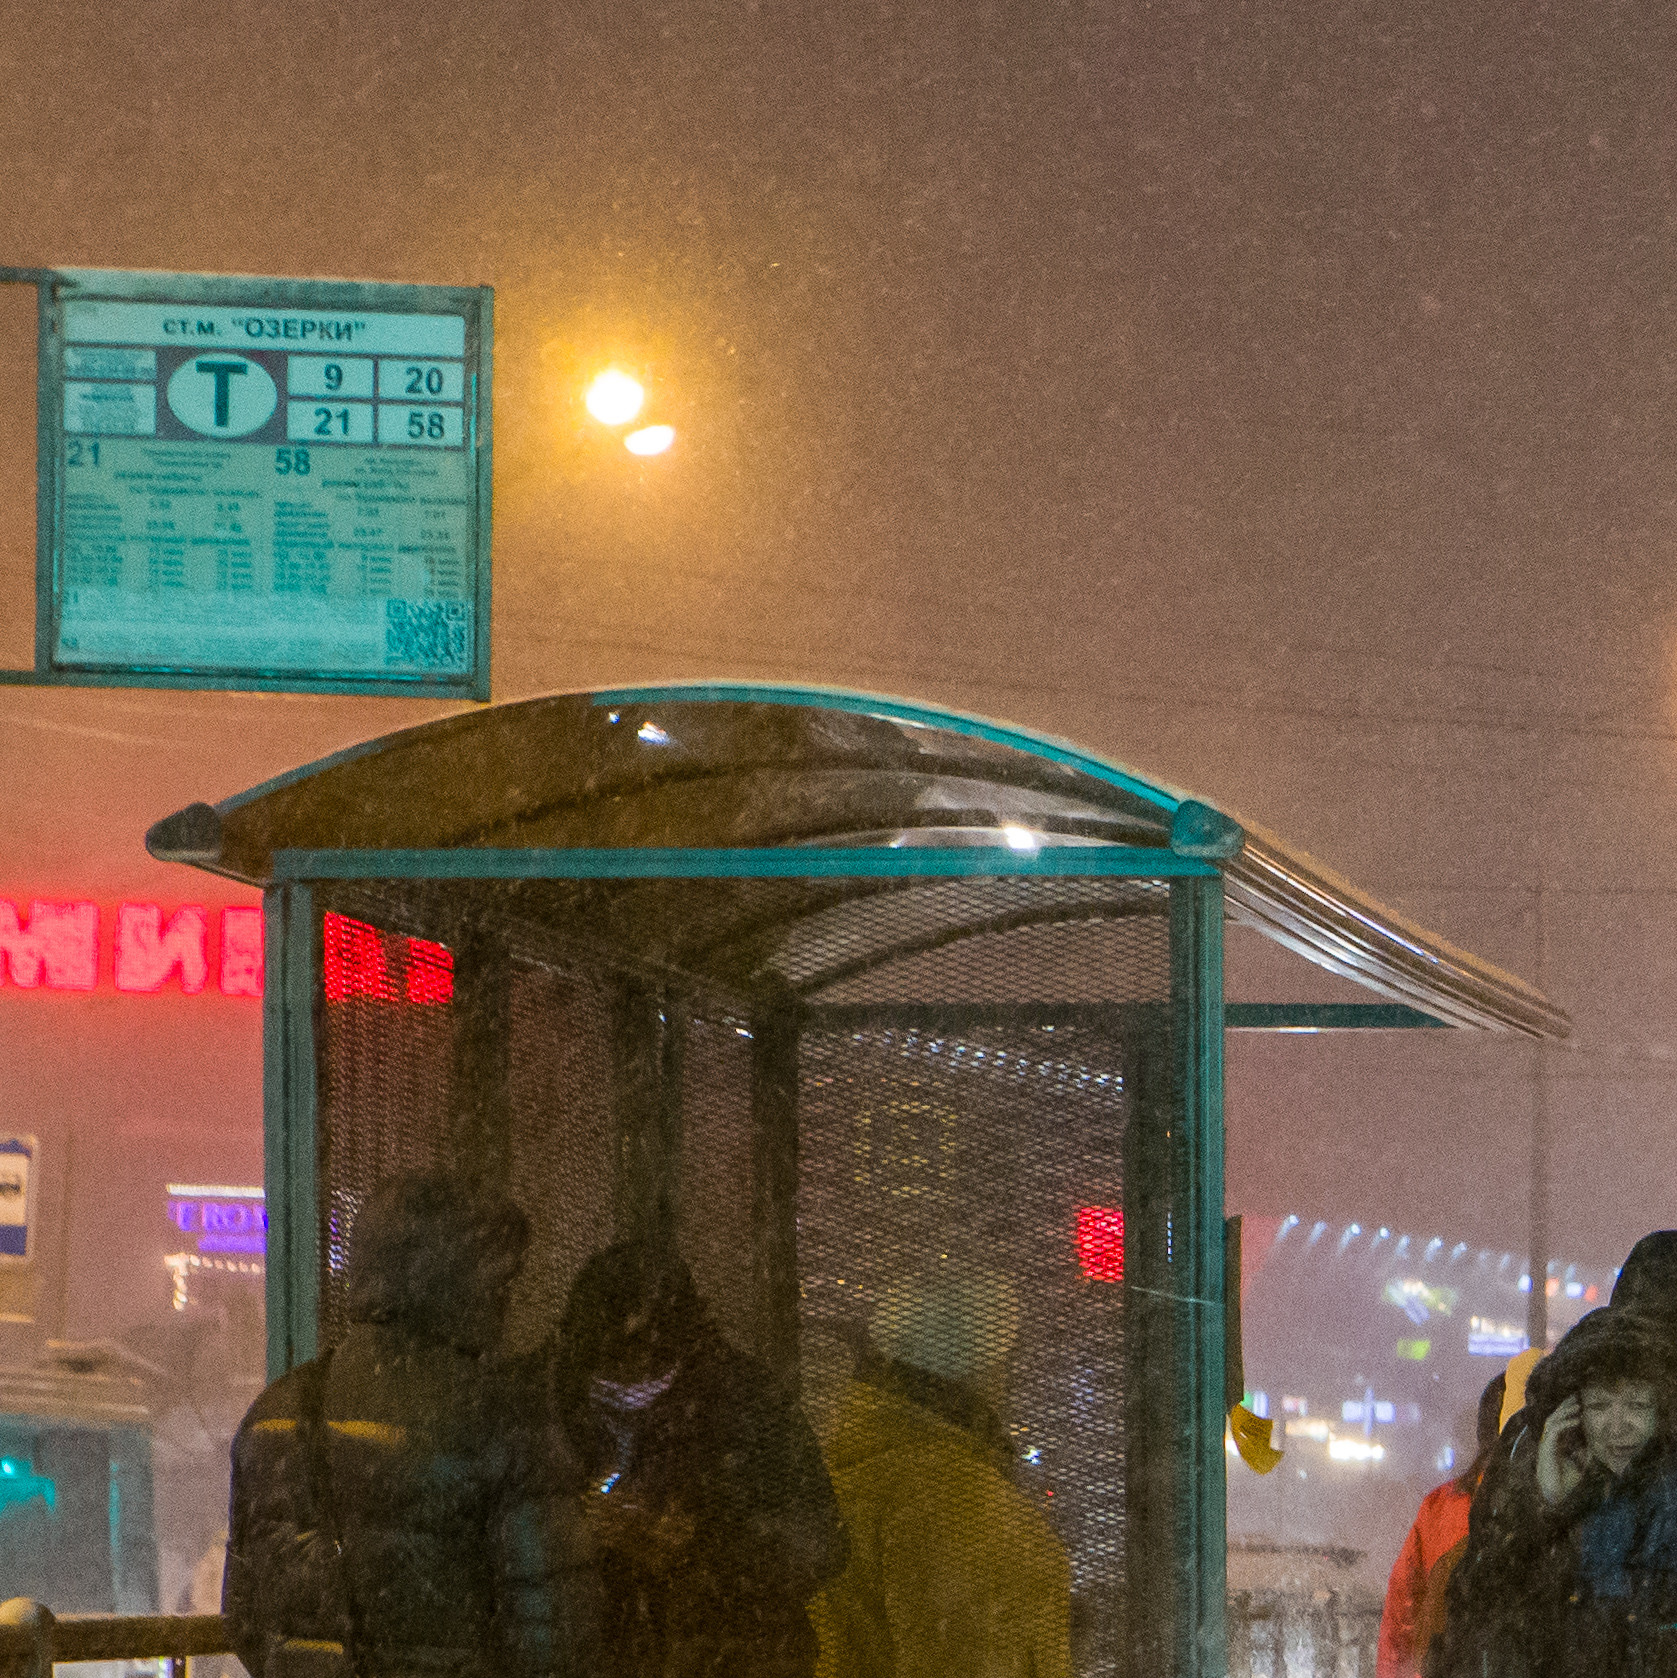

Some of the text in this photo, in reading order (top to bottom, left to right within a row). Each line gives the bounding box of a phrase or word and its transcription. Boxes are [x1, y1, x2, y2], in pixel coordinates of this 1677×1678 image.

[231, 317, 366, 342] "ОЗЕРКИ"
[324, 364, 443, 395] 9 20
[314, 408, 444, 439] 21 58
[67, 442, 101, 468] 21
[274, 447, 311, 476] 58
